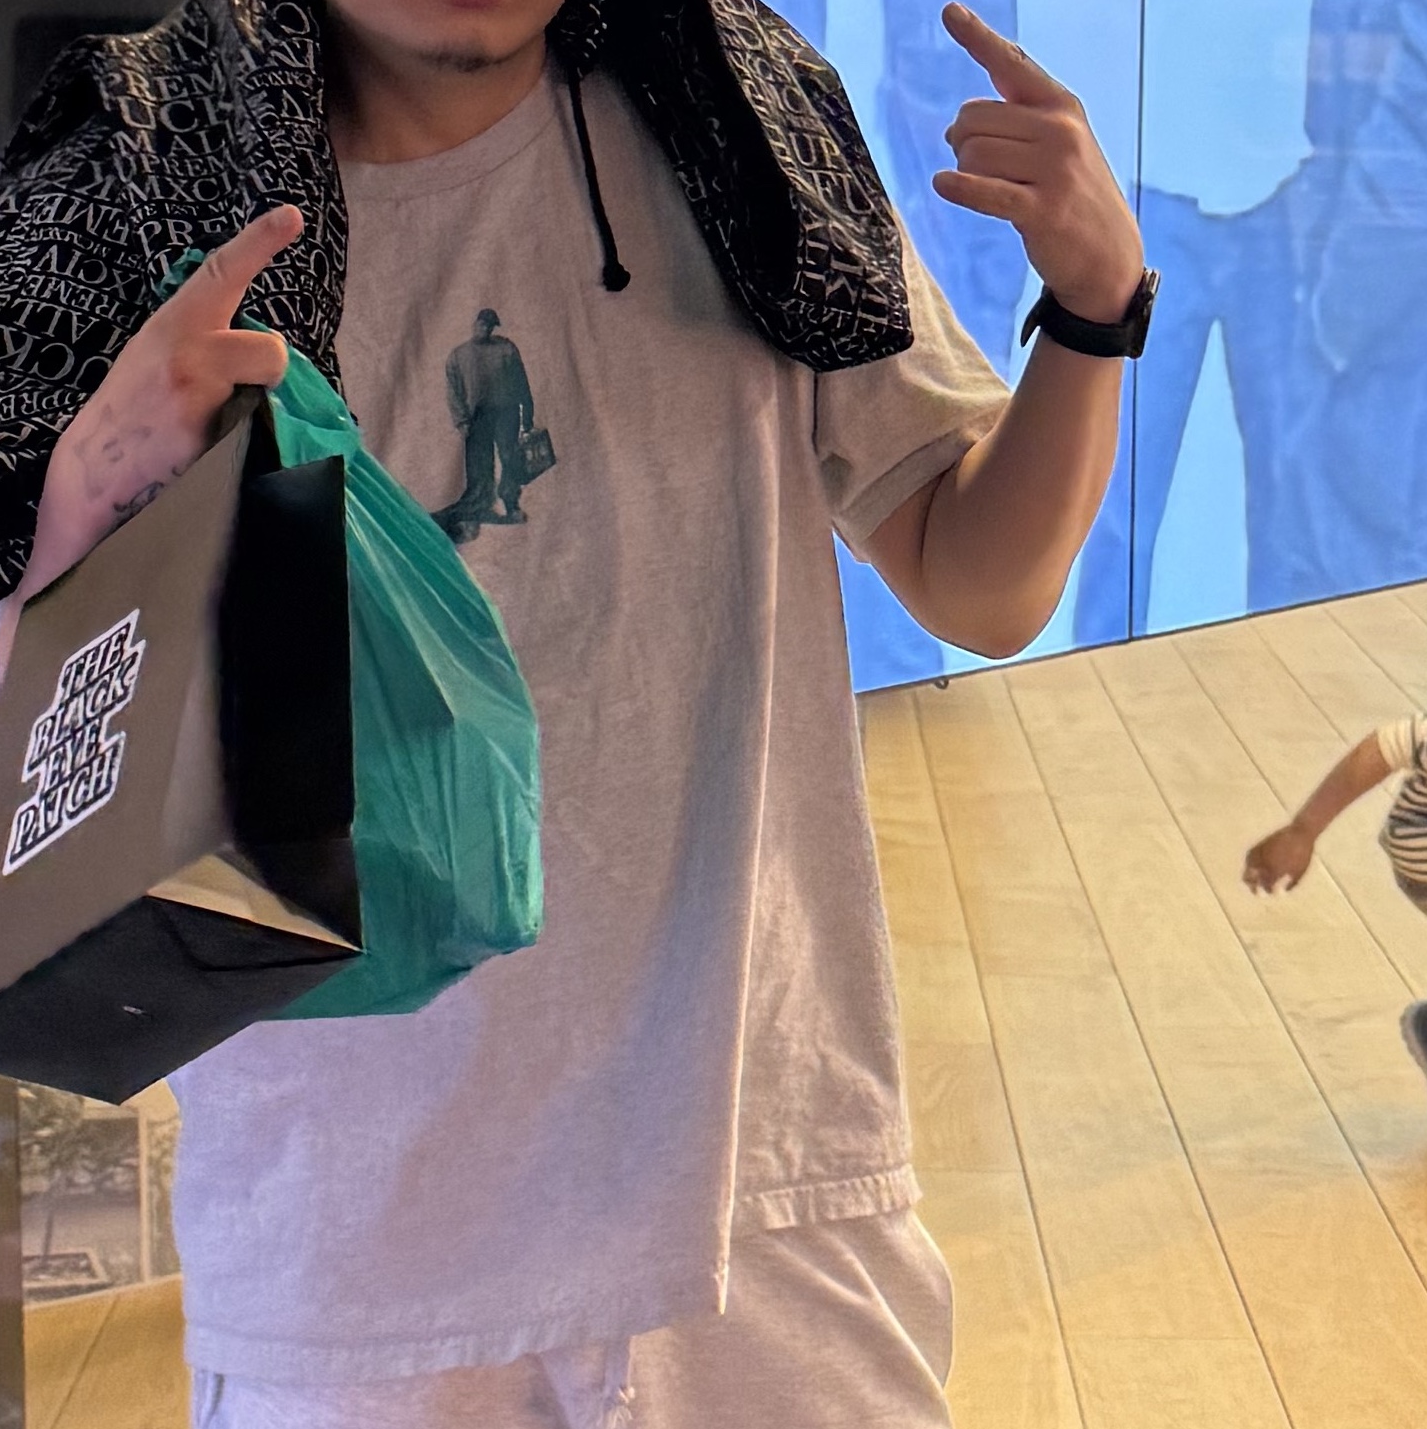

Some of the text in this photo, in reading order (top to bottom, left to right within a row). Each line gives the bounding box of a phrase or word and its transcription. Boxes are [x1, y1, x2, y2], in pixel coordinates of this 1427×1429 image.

[28, 651, 138, 772] BLACK
[61, 623, 131, 704] THE
[9, 740, 119, 864] PATCH
